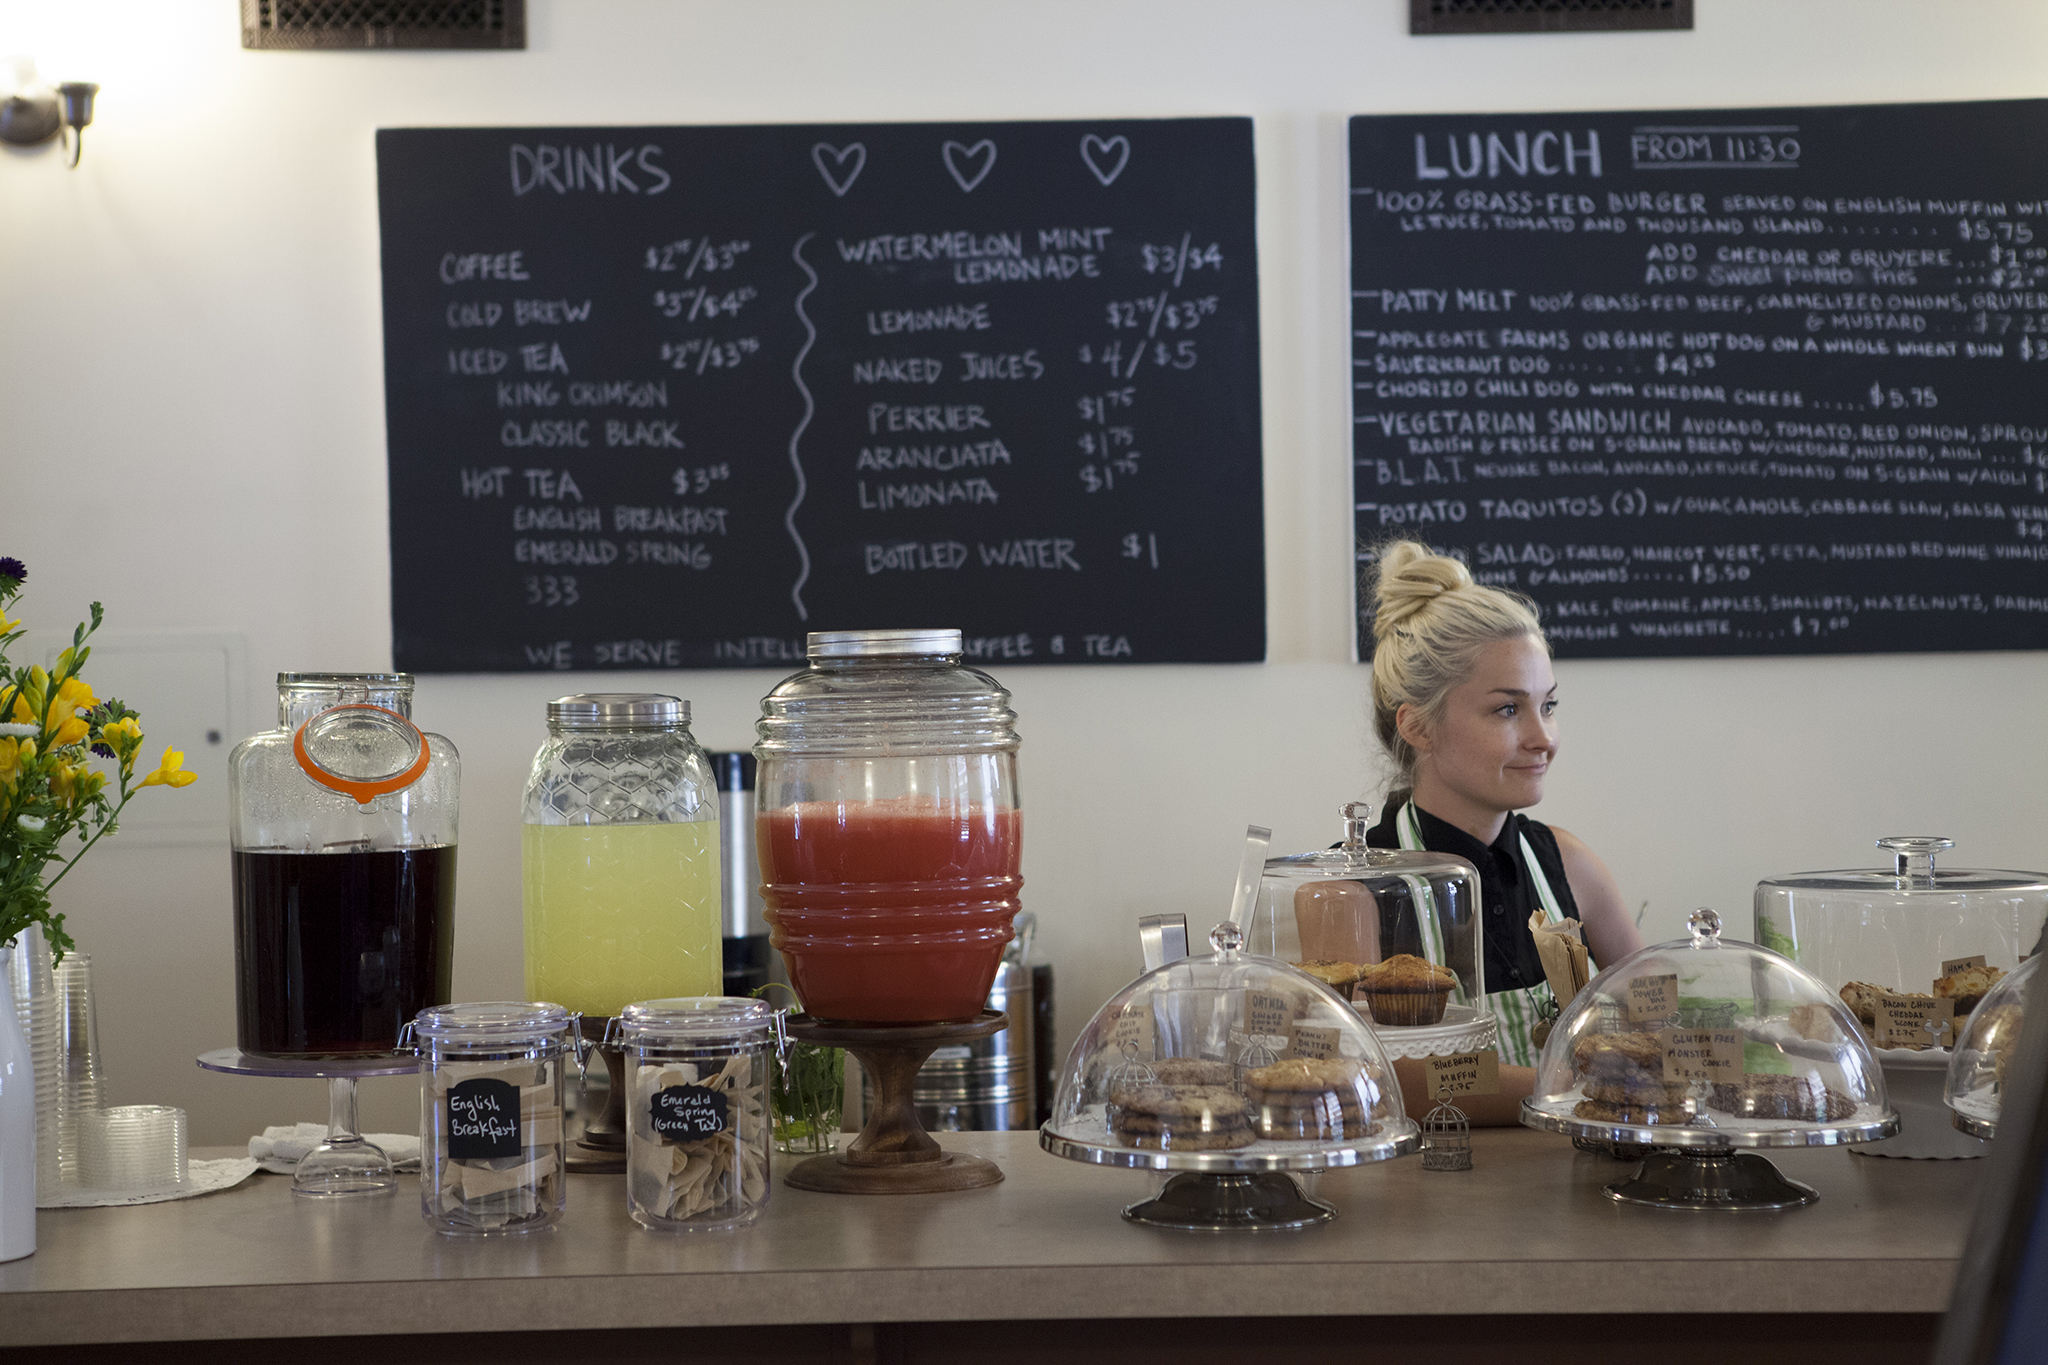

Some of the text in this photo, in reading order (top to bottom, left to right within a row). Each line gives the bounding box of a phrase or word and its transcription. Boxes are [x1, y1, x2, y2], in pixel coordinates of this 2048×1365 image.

[1415, 128, 1602, 179] LUNCH
[1632, 134, 1801, 162] FROM 11:30
[510, 142, 671, 196] DRINKS
[1376, 189, 1445, 213] 100%
[1455, 190, 1596, 215] GRASS-FED
[1607, 190, 1706, 215] BURGER
[1722, 194, 1796, 213] SERVED
[1802, 196, 1828, 213] ON
[1834, 196, 1921, 215] ENGLISH
[1927, 198, 2007, 216] MUFFIN
[1583, 216, 1627, 234] AND
[1636, 215, 1744, 235] THOUSAND
[1753, 216, 1825, 234] ISLAND
[837, 227, 1113, 264] WATERMELON MINT
[1647, 243, 1697, 262] ADD
[1716, 246, 1810, 267] CHEDDAR
[439, 250, 530, 285] COFFEE
[954, 254, 1101, 285] LEMONADE
[1645, 264, 1698, 284] ADD
[446, 299, 592, 329] COLD BREW
[1381, 289, 1448, 313] PATTY
[1456, 289, 1517, 312] MELT
[866, 301, 991, 336] LEMONADE
[1831, 312, 1927, 333] MUSTARD
[1500, 328, 1570, 350] FARMS
[1582, 330, 1676, 350] ORGANIC
[1682, 331, 1720, 350] HOT
[1726, 332, 1766, 351] DOG
[1772, 335, 1799, 352] ON
[1803, 336, 1819, 353] A
[1824, 337, 1889, 355] WHOLE
[1898, 339, 1956, 357] WHEAT
[1965, 340, 2004, 358] BUN
[447, 341, 569, 375] ICED TEA
[853, 347, 1045, 385] NAKED JUICES
[1375, 352, 1550, 375] SAUERKRAUT DOG
[497, 379, 668, 409] KING CRIMSON
[1376, 379, 1468, 398] CHORIZO
[1474, 379, 1529, 398] CHILI
[1533, 379, 1580, 399] DOG
[1588, 382, 1635, 397] WITH
[1642, 382, 1727, 402] CHEDDAR
[1733, 386, 1803, 406] CHEESE
[867, 402, 991, 436] PERRIER
[1378, 409, 1536, 437] VEGETARIAN
[1547, 406, 1671, 436] SANDWICH
[1861, 423, 1899, 442] RED
[501, 418, 686, 450] CLASSIC BLACK
[1566, 437, 1595, 452] ON
[856, 437, 1011, 472] ARANCIATA
[461, 465, 584, 502] HOT TEA
[1844, 464, 1869, 481] ON
[857, 476, 999, 511] LIMONATA
[1379, 501, 1467, 525] POTATO
[1481, 497, 1604, 521] TAQUITOS
[1610, 487, 1648, 517] (3)
[1952, 501, 2006, 519] SALSA
[513, 504, 730, 536] ENGLISH BREAKFAST
[514, 537, 712, 571] EMERALD SPRING
[864, 541, 968, 575] BOTTLED
[978, 538, 1082, 572] WATER
[1909, 540, 1944, 559] RED
[524, 574, 580, 608] 333
[525, 641, 574, 670] WE
[595, 638, 683, 667] SERVE
[1083, 634, 1132, 658] TEA
[1947, 963, 1965, 975] HAM
[1882, 999, 1907, 1009] BACON
[1889, 1010, 1925, 1019] CHEDDAR
[1894, 1020, 1921, 1028] SCONE
[1297, 1038, 1333, 1052] BUTTER
[1668, 1049, 1712, 1058] MONSTER
[1672, 1034, 1736, 1045] GLUTEN FREE
[1441, 1070, 1477, 1082] MUFFIN
[1702, 1059, 1731, 1068] COOKIE
[451, 1094, 500, 1122] English
[660, 1093, 711, 1107] Emerald
[452, 1116, 517, 1144] Breakfast
[673, 1106, 716, 1126] Spring
